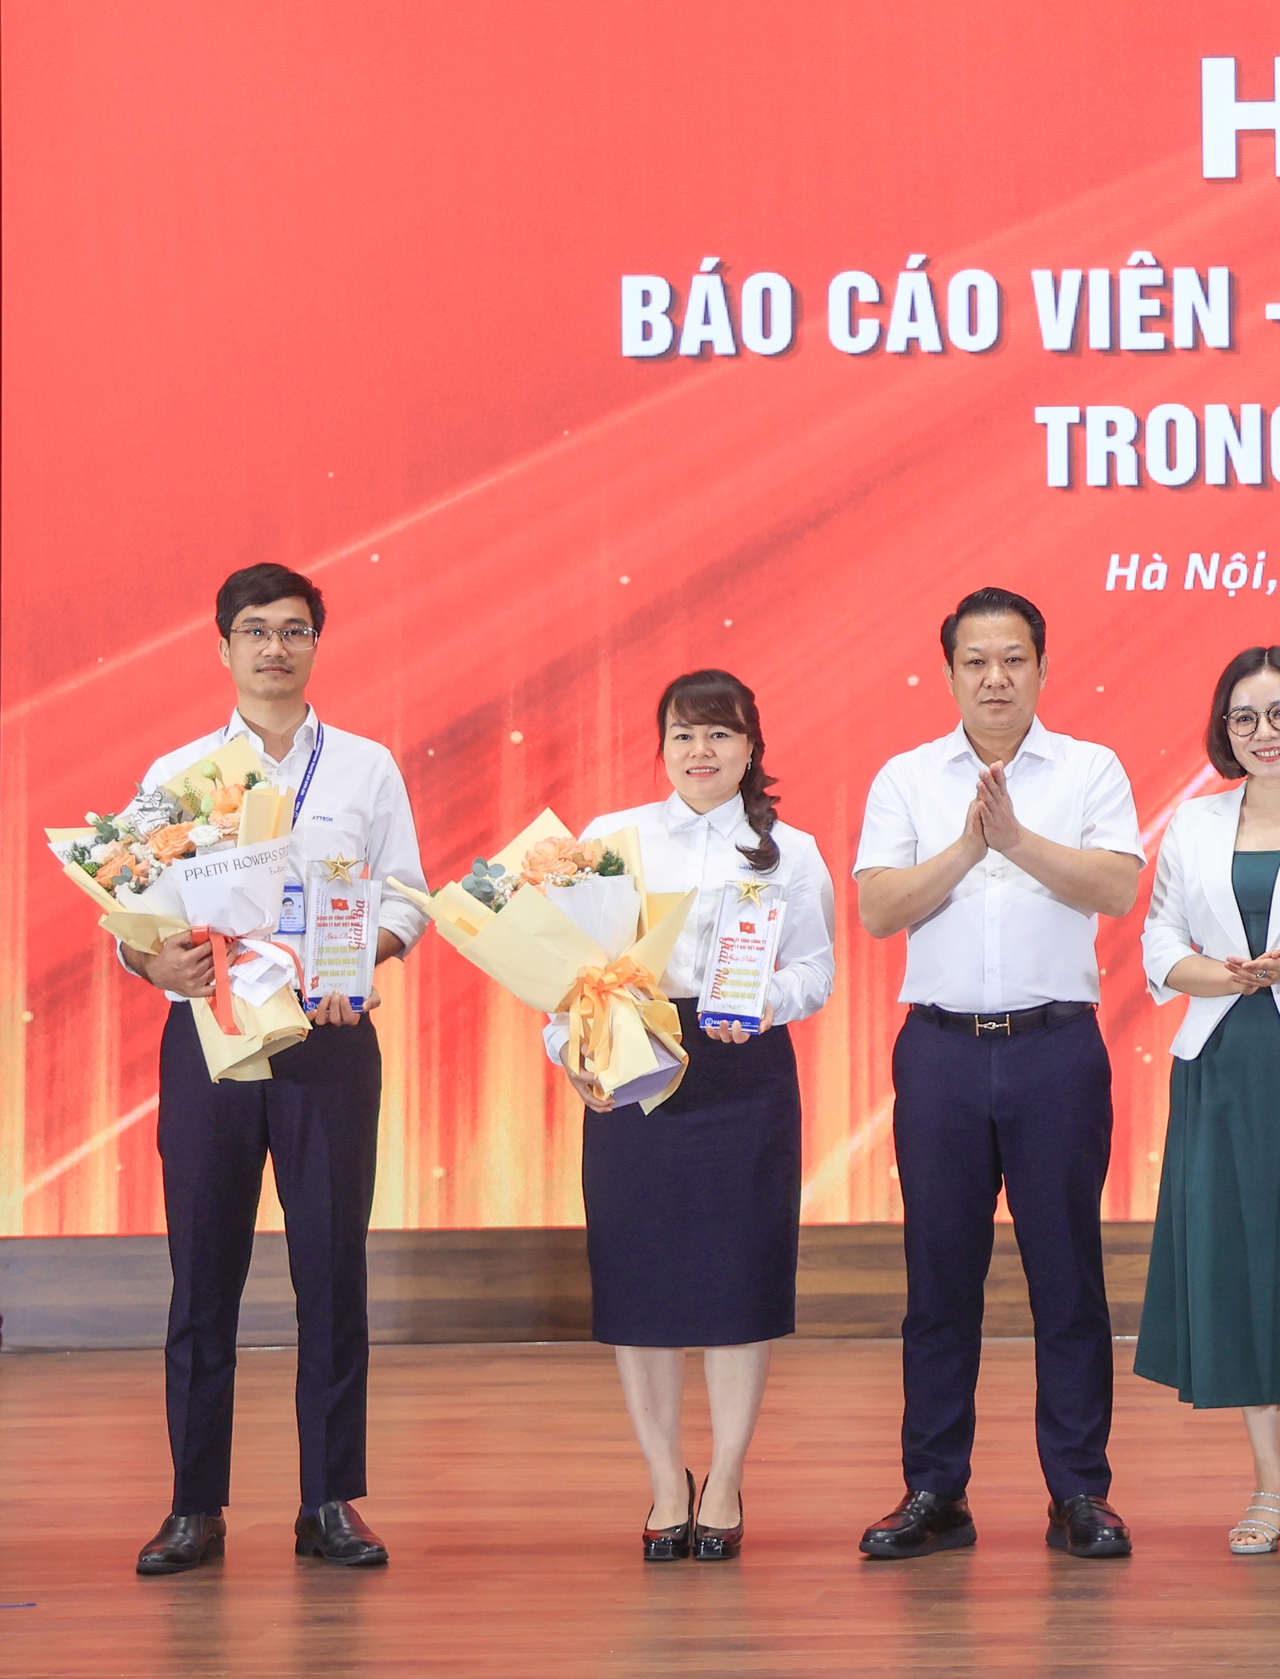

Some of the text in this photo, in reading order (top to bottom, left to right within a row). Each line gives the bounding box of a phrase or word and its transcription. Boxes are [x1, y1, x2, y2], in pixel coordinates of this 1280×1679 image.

[621, 256, 794, 359] BÁO
[828, 254, 1000, 356] CÁO
[1031, 250, 1232, 352] VIÊN
[1104, 553, 1169, 592] Hà
[1183, 551, 1278, 597] Nội,
[311, 815, 334, 823] ATTECH
[184, 860, 230, 882] PRETTY
[232, 849, 278, 871] FLOWERS
